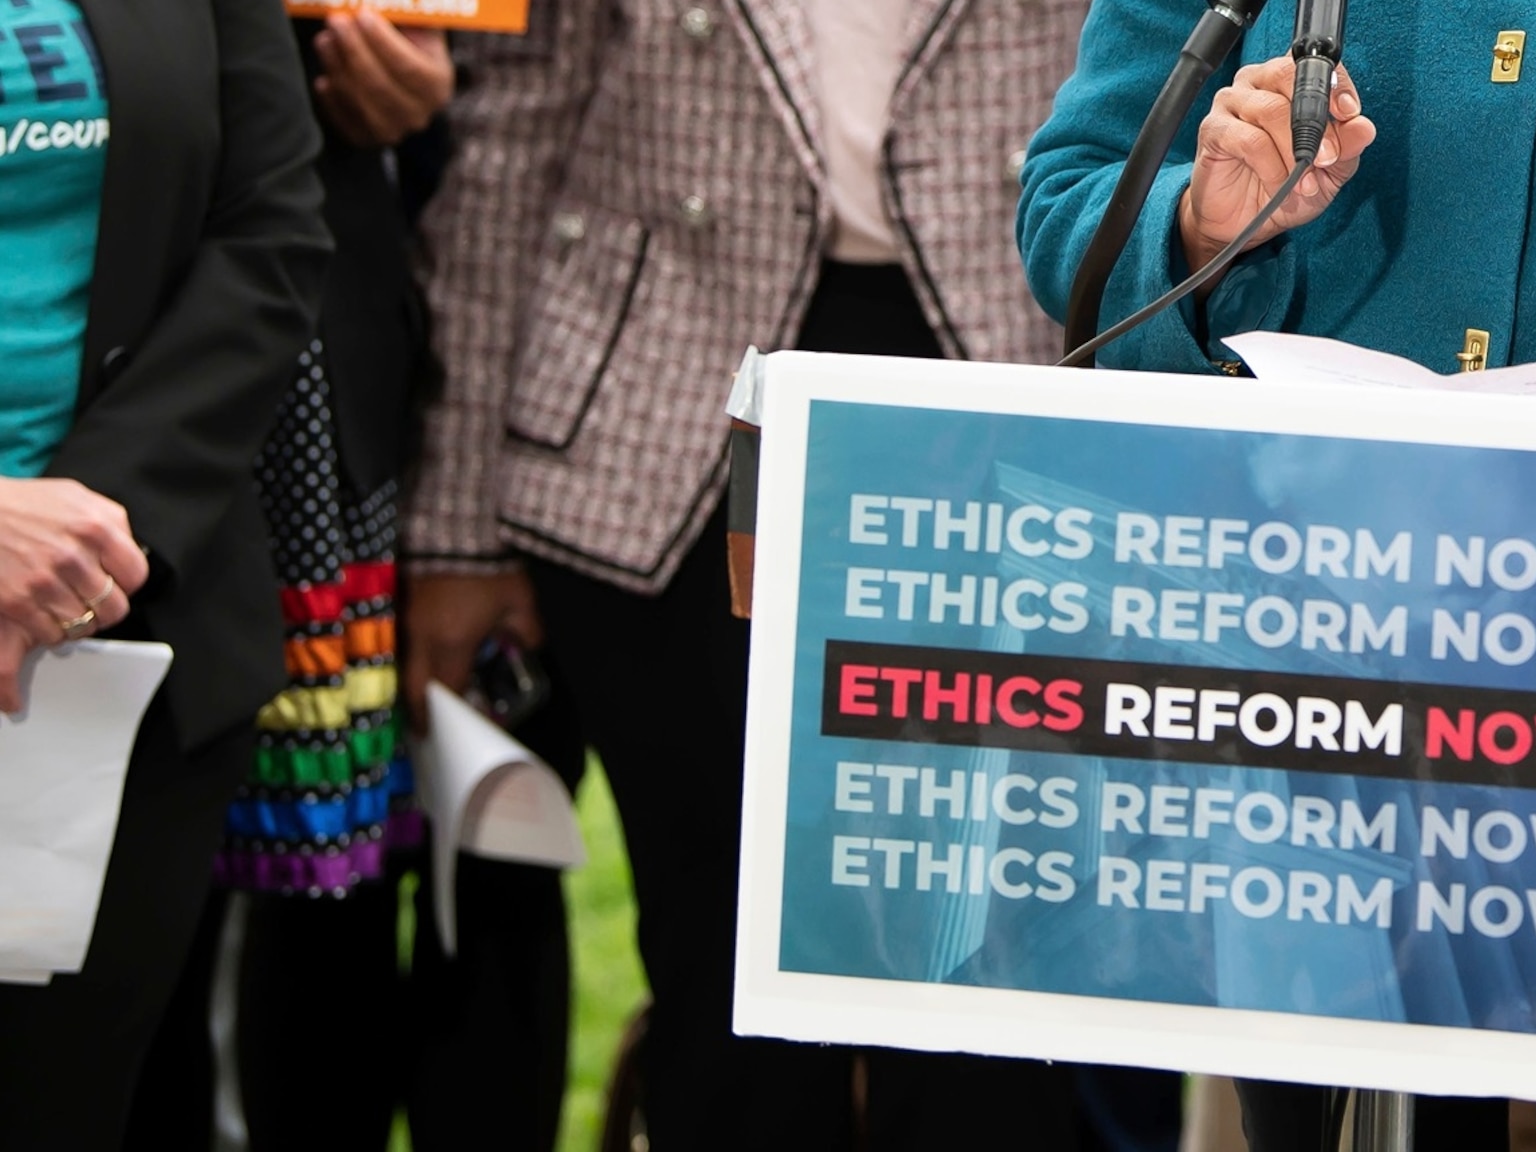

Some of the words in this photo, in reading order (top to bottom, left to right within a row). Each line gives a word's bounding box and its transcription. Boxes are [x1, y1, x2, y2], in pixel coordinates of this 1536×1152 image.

[849, 493, 1093, 561] ETHICS
[1114, 512, 1412, 583] REFORM
[844, 567, 1090, 635] ETHICS
[1110, 585, 1408, 657] REFORM
[838, 663, 1084, 732] ETHICS
[1104, 682, 1403, 756] REFORM
[834, 762, 1079, 830] ETHICS
[1100, 781, 1398, 854] REFORM
[831, 835, 1076, 903] ETHICS
[1097, 854, 1394, 929] REFORM
